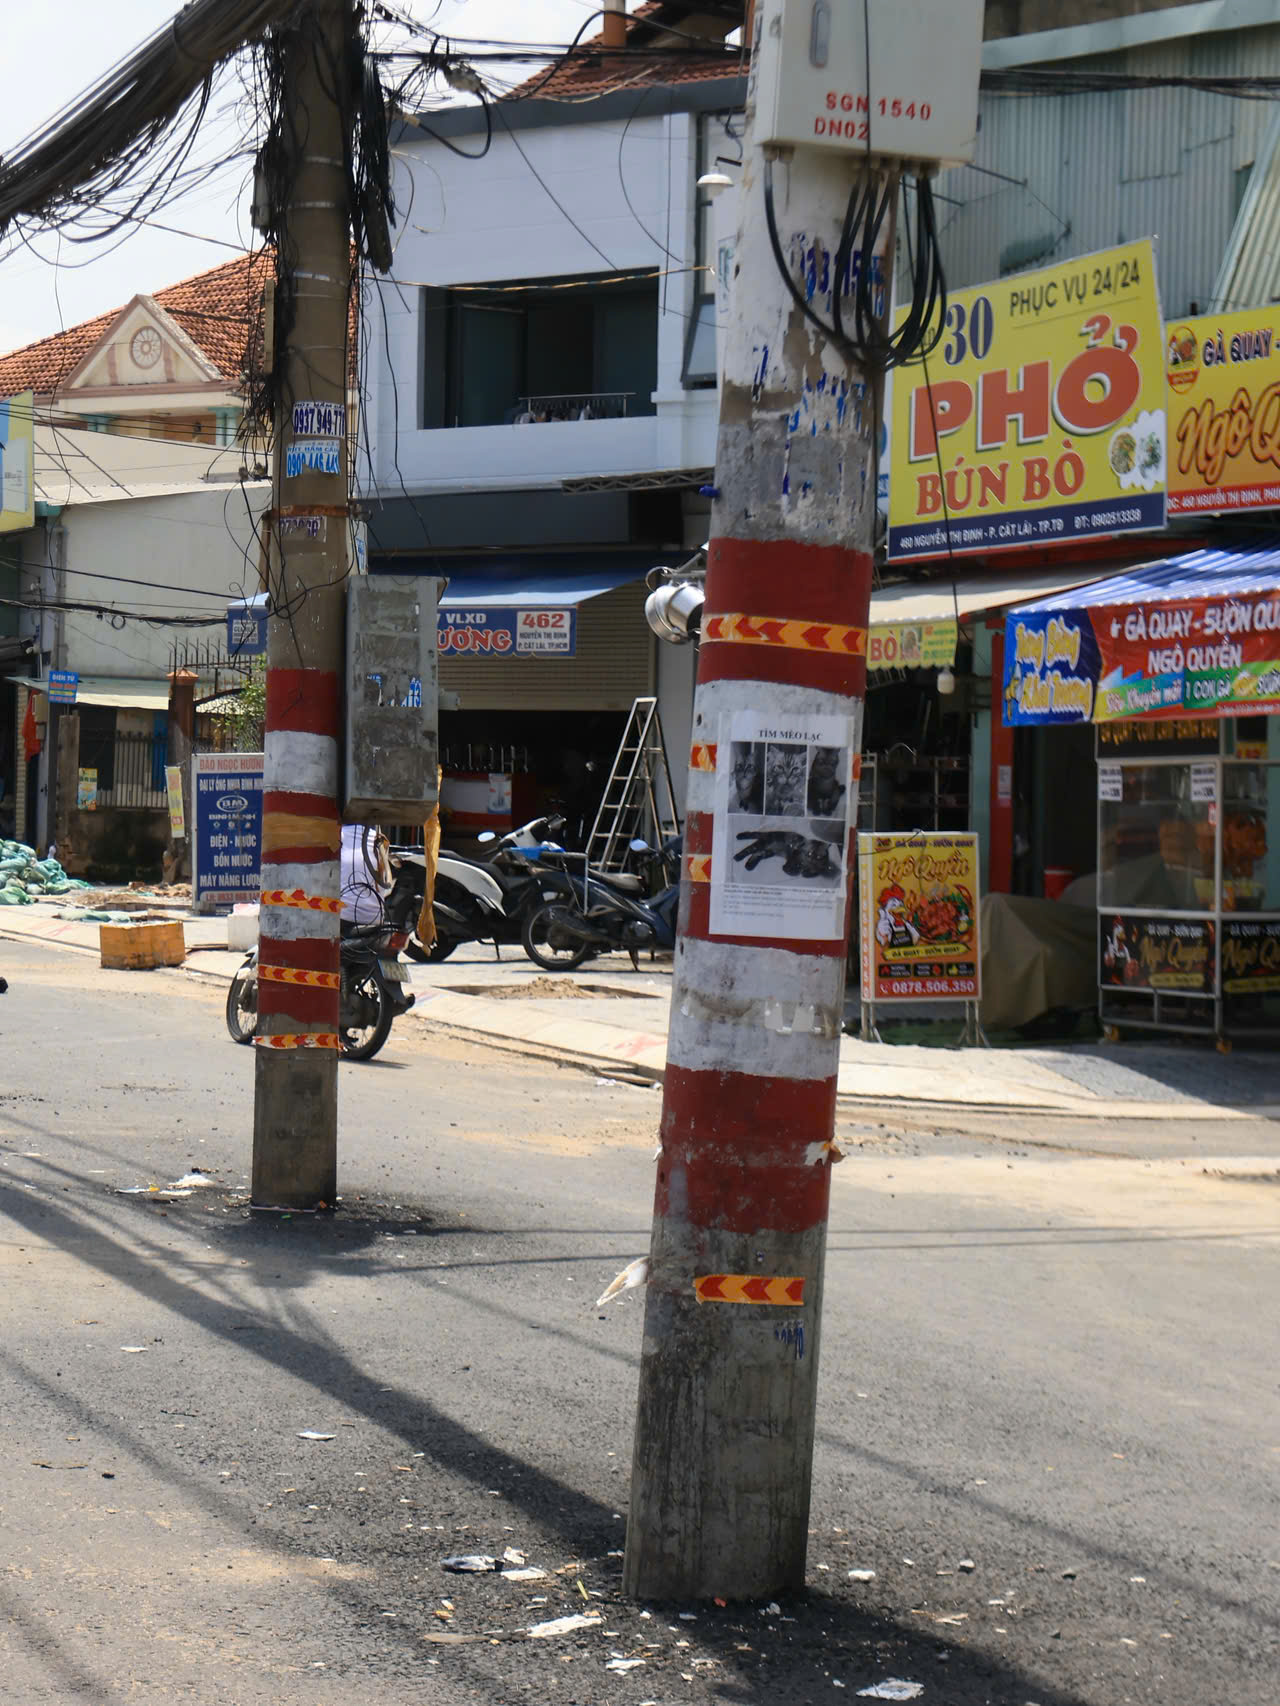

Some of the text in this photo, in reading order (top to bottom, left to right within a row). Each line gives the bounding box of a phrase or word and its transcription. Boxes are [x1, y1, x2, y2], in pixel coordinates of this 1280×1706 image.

[825, 91, 932, 121] SGN 1540
[814, 116, 869, 140] DN02
[1009, 258, 1141, 317] PHỤC VỤ 24/24
[943, 296, 994, 366] 30
[1203, 327, 1273, 368] GÀ QUAY
[909, 313, 1141, 463] PHỞ
[916, 439, 1085, 516] BÚN BÒ
[913, 528, 948, 548] NGUYỄN
[949, 530, 962, 545] THỊ
[963, 527, 983, 543] ĐỊNH
[446, 612, 487, 624] VLXD
[522, 612, 565, 629] 462
[1124, 606, 1148, 642] GÀ
[1149, 609, 1193, 640] QUAY
[1203, 599, 1253, 636] SƯỜN
[437, 625, 513, 653] ƯƠNG
[870, 629, 897, 661] BÒ
[1147, 633, 1243, 676] NGÔ QUYỀN
[759, 728, 778, 739] TÌM
[780, 729, 802, 740] MÈO
[241, 873, 261, 889] LƯỢN
